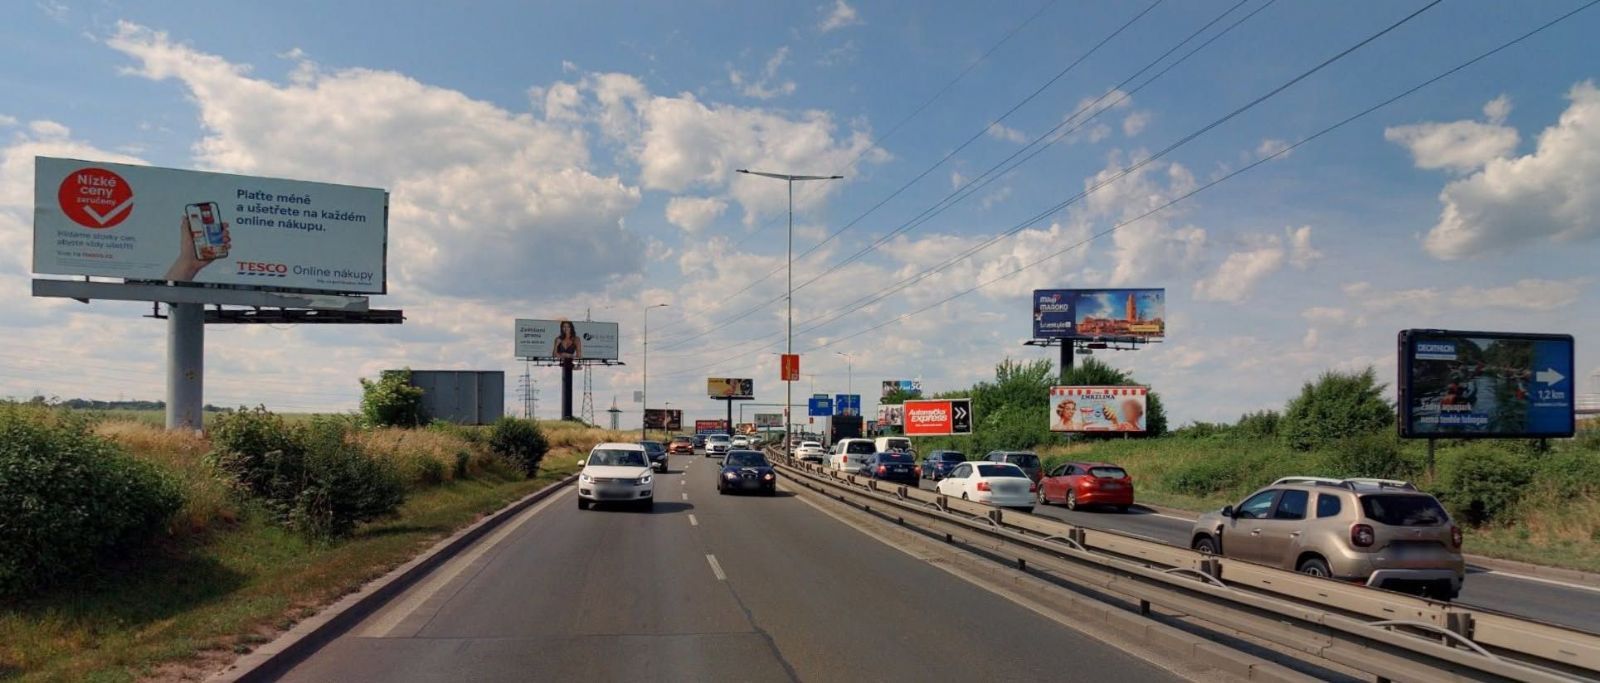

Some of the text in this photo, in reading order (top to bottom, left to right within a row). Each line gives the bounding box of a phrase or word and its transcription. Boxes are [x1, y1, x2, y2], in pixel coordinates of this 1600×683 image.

[80, 186, 113, 199] ceny
[237, 189, 311, 205] Plaťte méně
[236, 203, 366, 222] a ušetřete na každém
[236, 216, 326, 232] online nákupu.
[237, 261, 373, 281] TESCO Online nákupy
[1418, 344, 1455, 352] DECATHLON
[1537, 389, 1565, 400] 1,2 km
